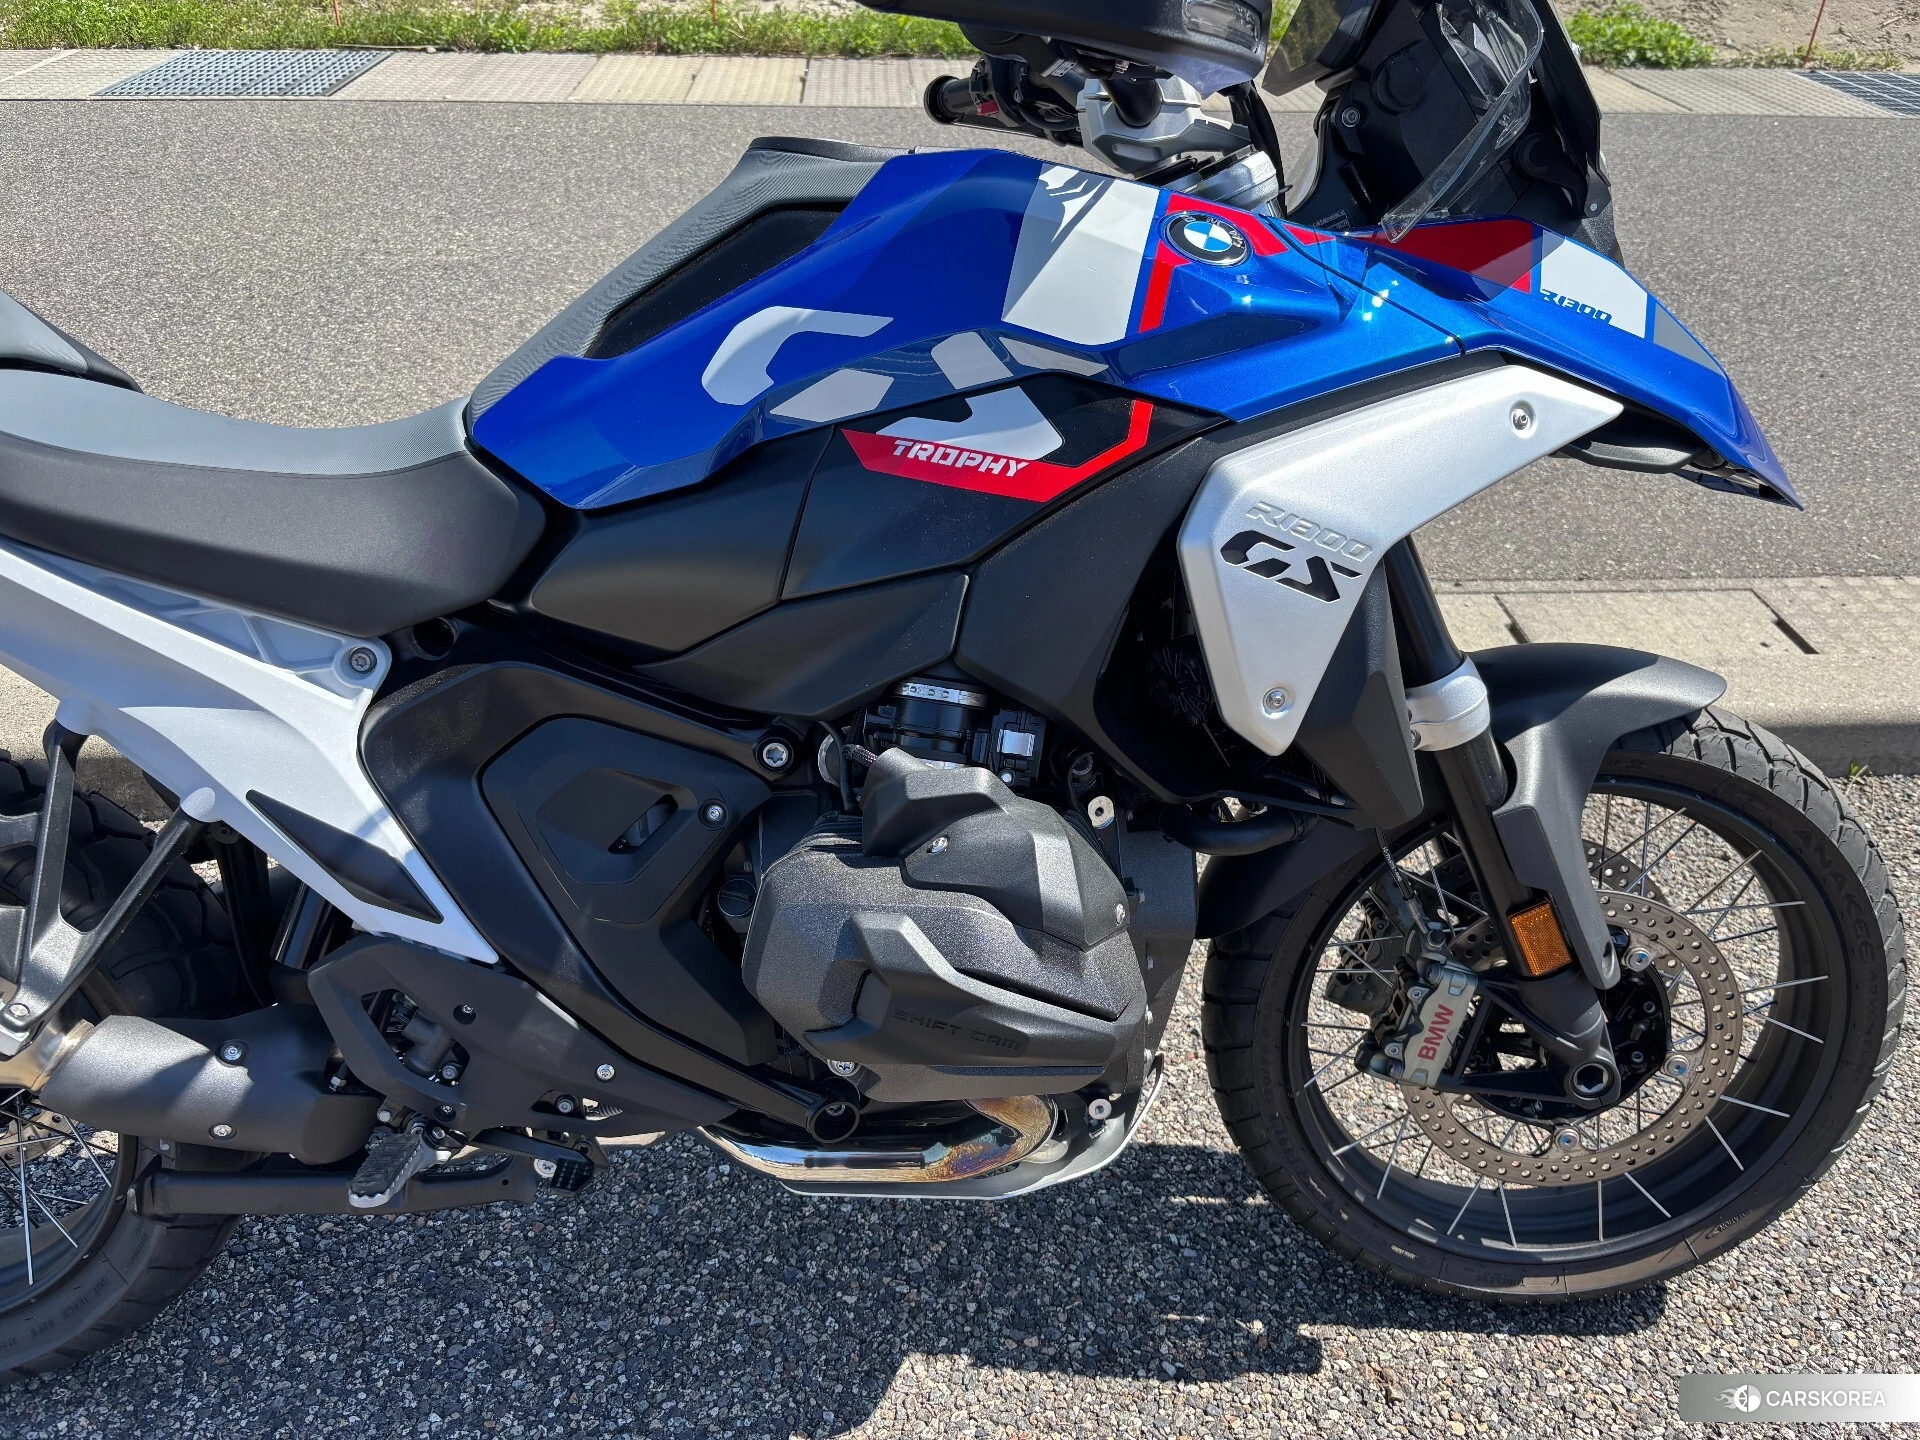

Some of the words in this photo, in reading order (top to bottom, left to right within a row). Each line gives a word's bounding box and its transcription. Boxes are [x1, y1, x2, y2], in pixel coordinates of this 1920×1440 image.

[892, 437, 1033, 478] TROPHY
[1220, 529, 1363, 604] GS
[893, 1008, 963, 1036] SHIFT
[970, 1030, 1021, 1051] CAM
[1417, 1003, 1455, 1061] BMW
